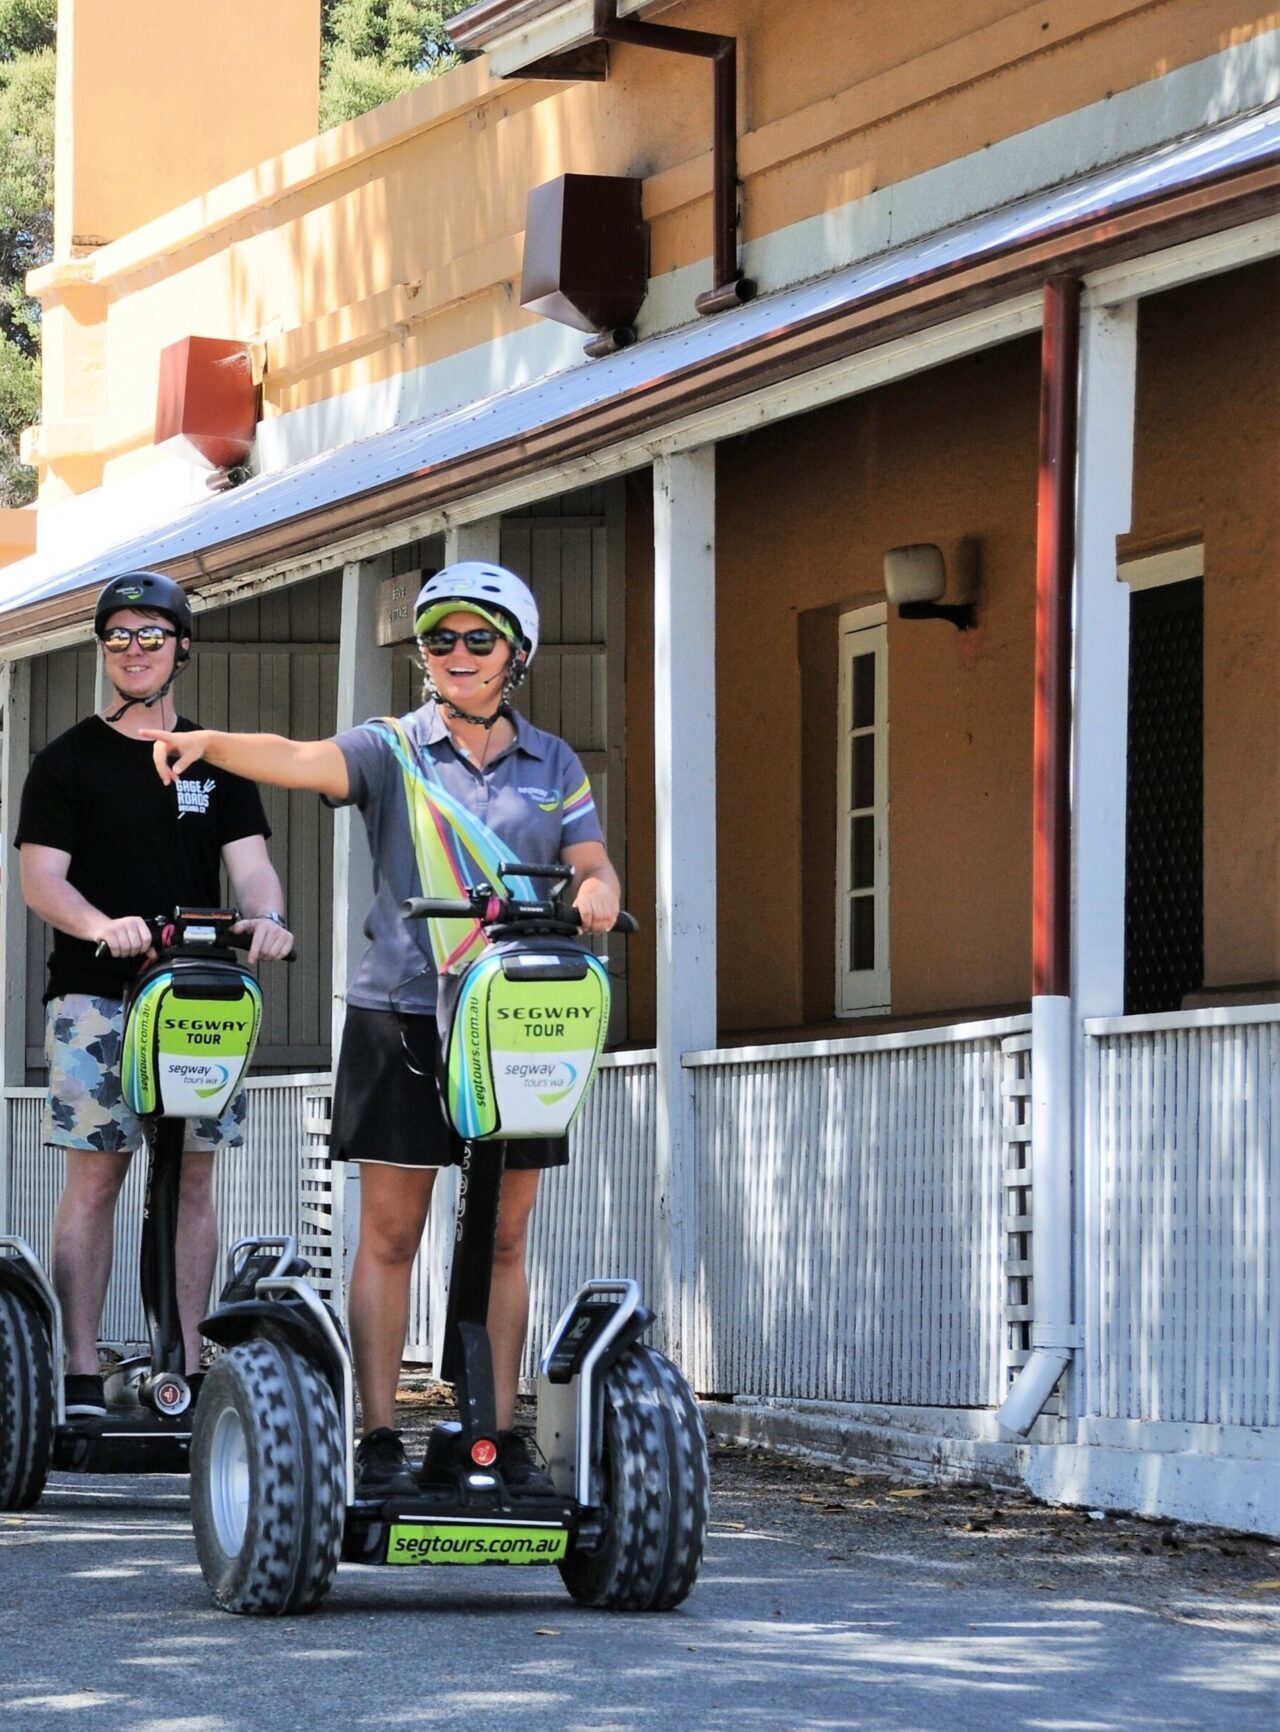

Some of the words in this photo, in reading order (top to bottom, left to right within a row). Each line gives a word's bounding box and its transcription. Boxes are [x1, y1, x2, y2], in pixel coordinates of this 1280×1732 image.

[176, 780, 201, 793] GAGE
[177, 792, 209, 807] ROADS
[497, 1006, 596, 1020] SEGWAY
[165, 1019, 249, 1031] SEGWAY
[523, 1024, 565, 1037] TOUR
[186, 1033, 222, 1044] TOUR
[141, 1003, 151, 1092] segtours.com.au
[471, 997, 487, 1107] segtours.com.au
[168, 1064, 212, 1075] segway
[504, 1063, 556, 1077] segway
[183, 1076, 205, 1084] tours
[524, 1078, 549, 1088] tours
[549, 1079, 564, 1087] wa
[395, 1536, 561, 1557] segtours.com.au
